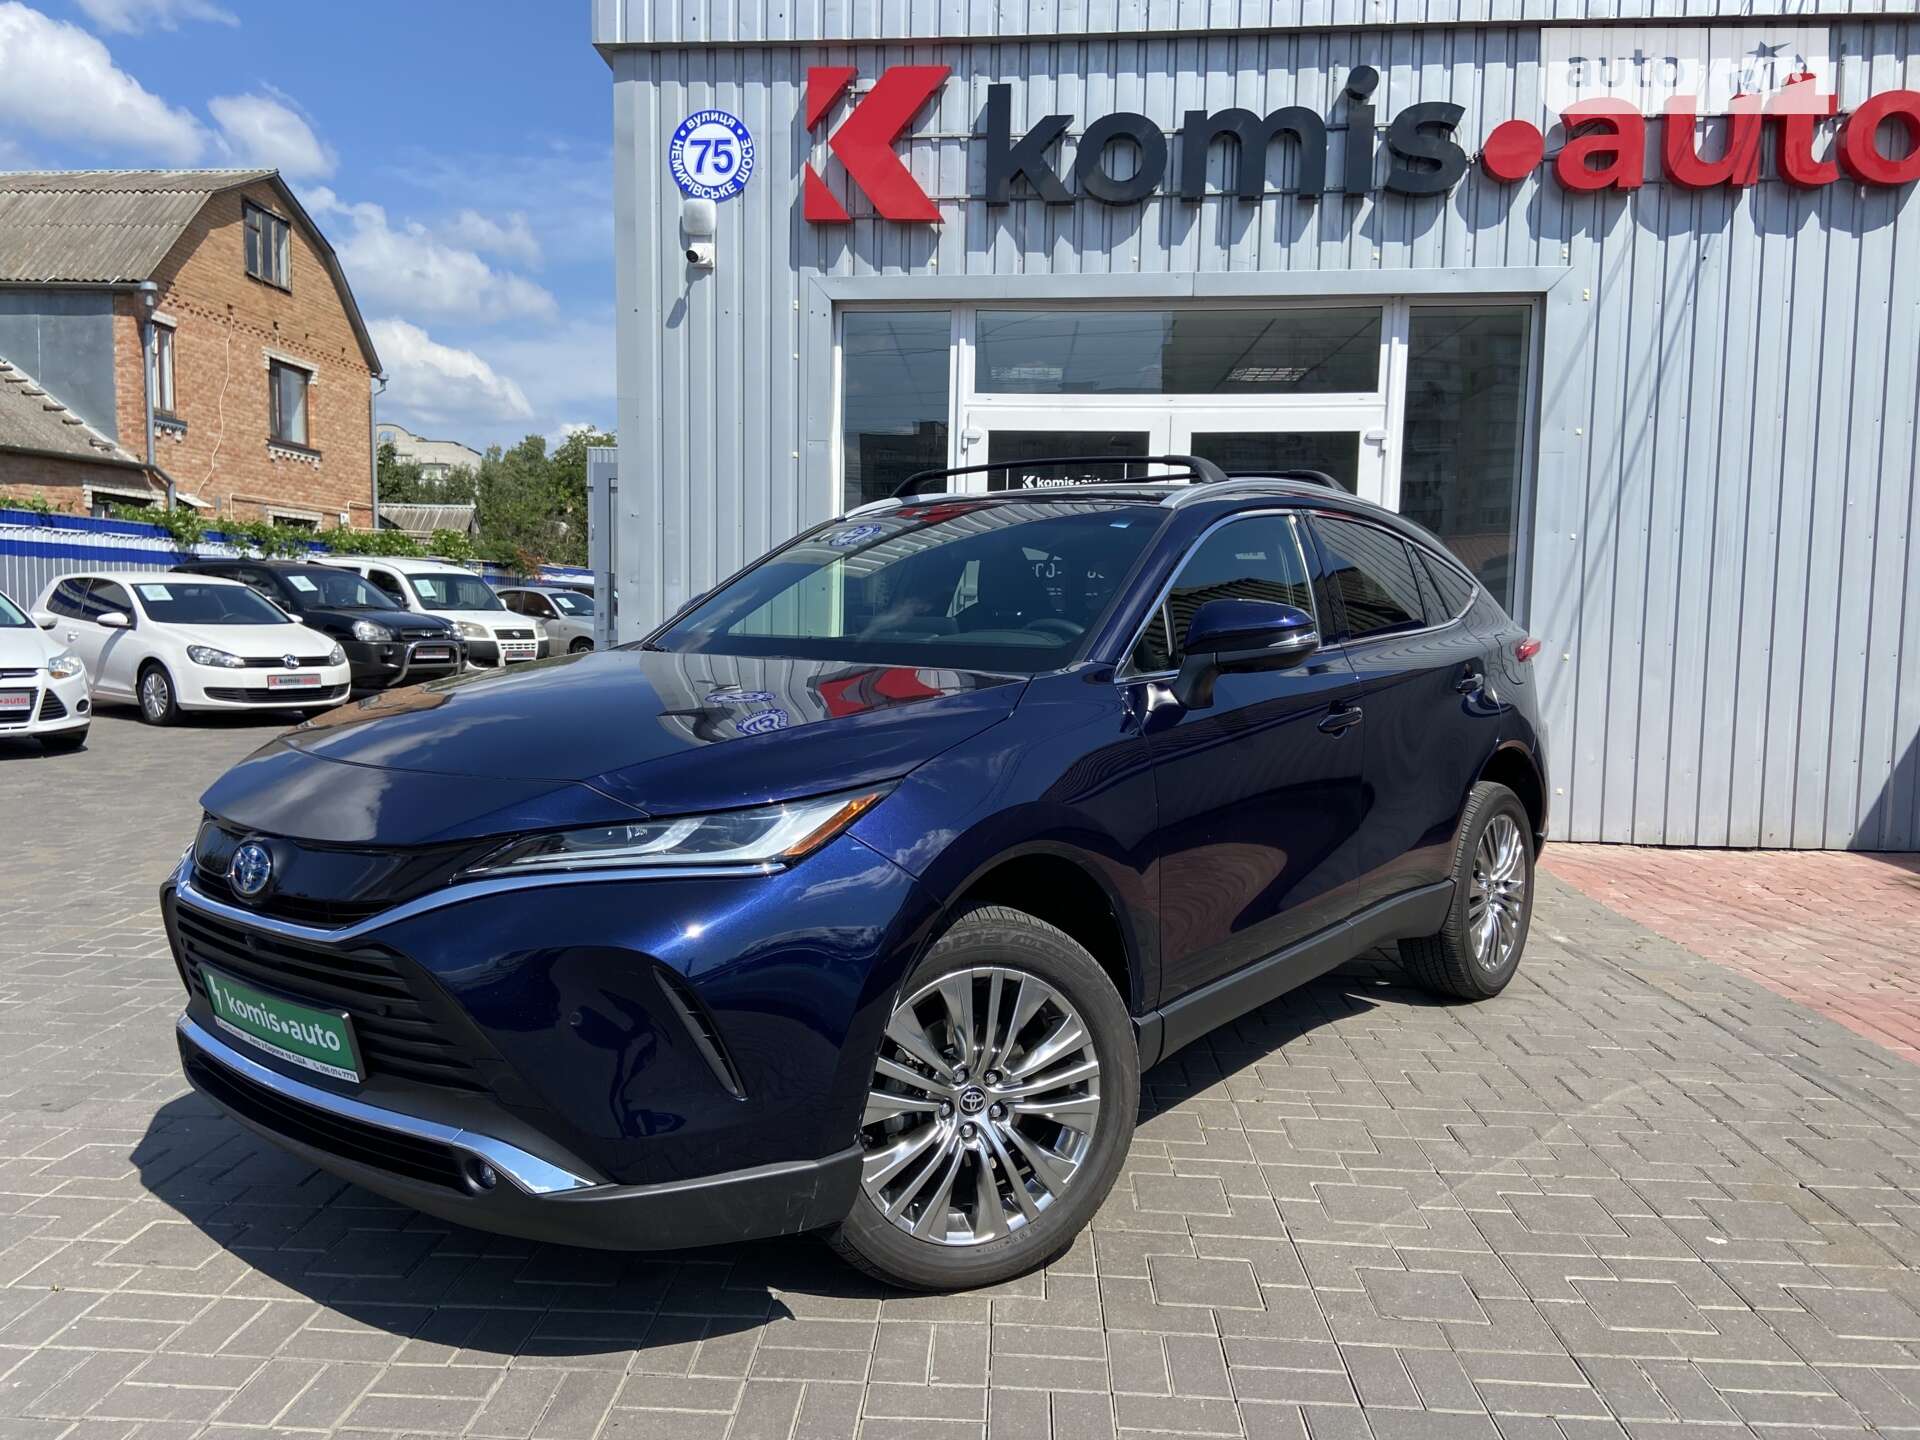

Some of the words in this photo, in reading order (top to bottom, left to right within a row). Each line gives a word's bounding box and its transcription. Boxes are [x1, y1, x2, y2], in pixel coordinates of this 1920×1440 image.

[672, 140, 737, 199] НЕМИРІВСЬКЕ
[736, 138, 753, 183] ШОСЕ
[690, 140, 733, 173] 75
